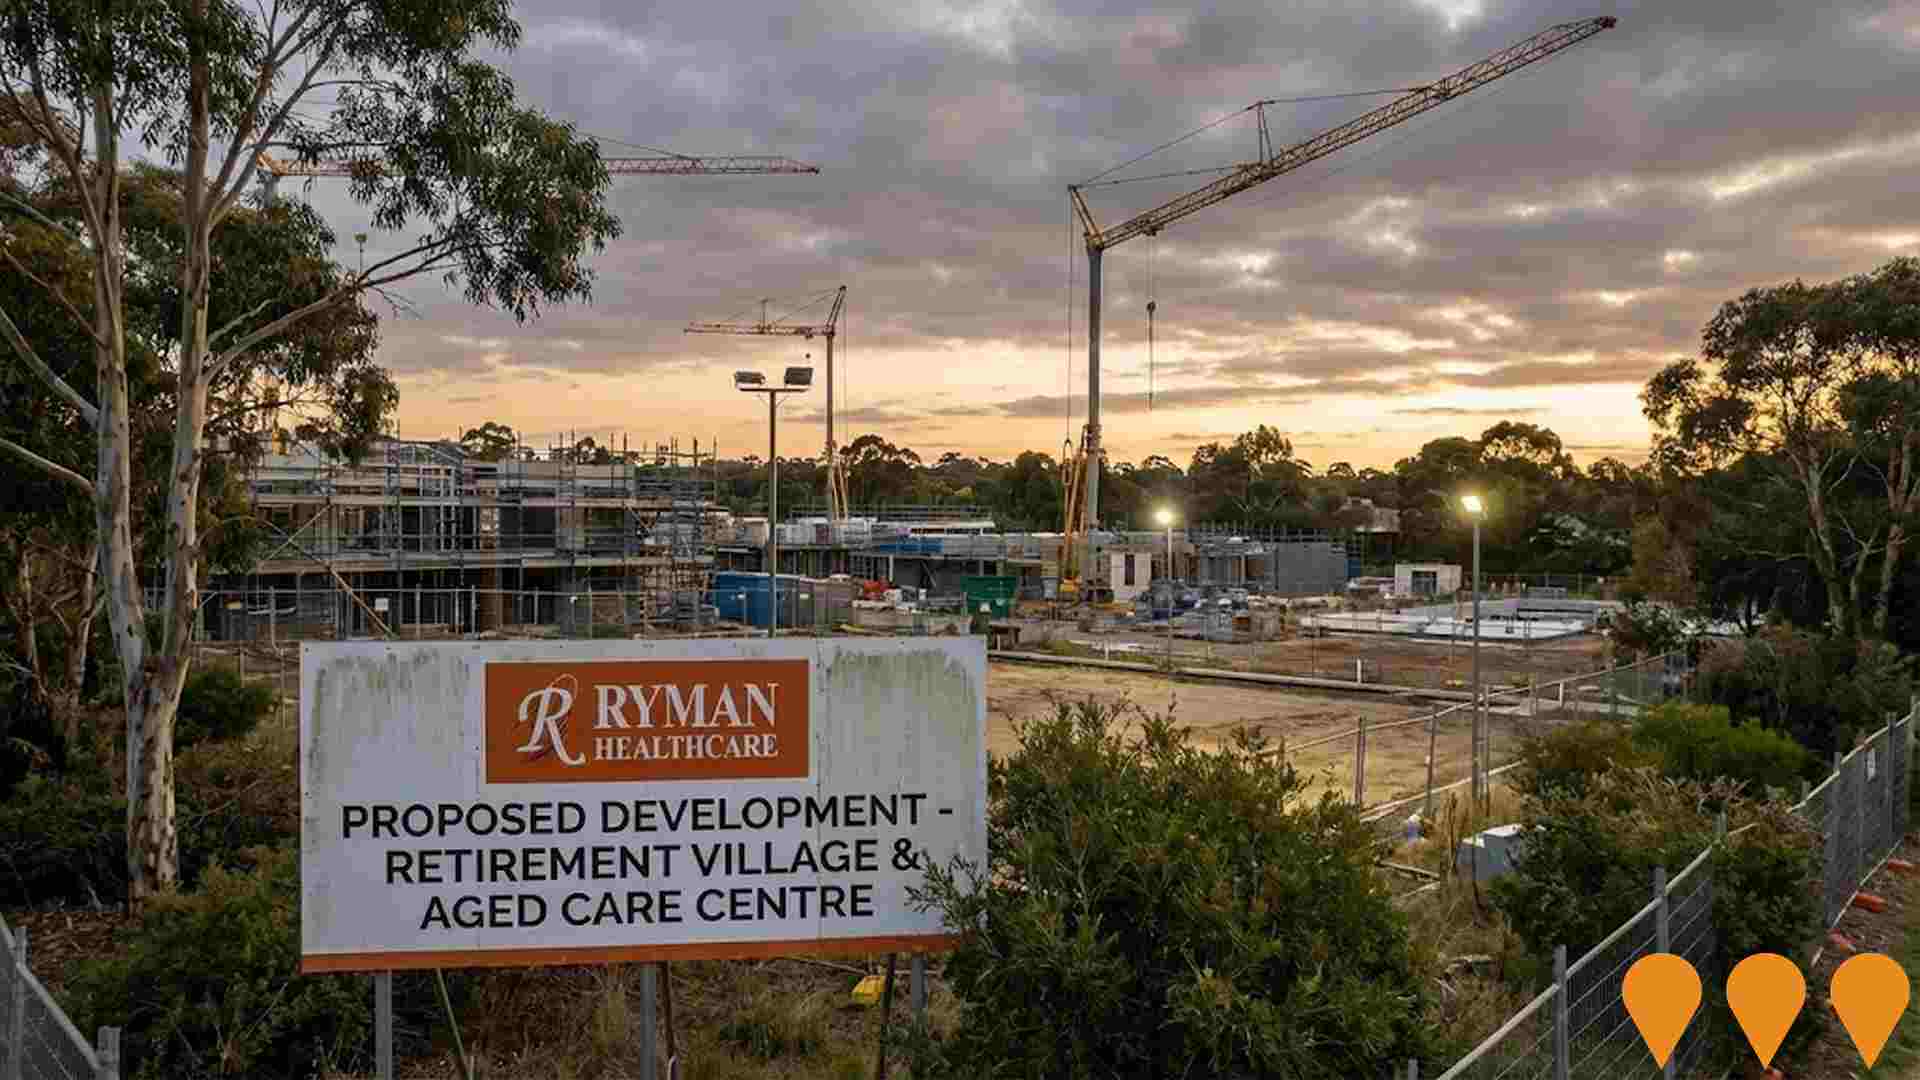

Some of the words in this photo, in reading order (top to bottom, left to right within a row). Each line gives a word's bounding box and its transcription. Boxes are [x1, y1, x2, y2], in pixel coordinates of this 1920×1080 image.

[516, 674, 587, 766] R
[592, 682, 779, 730] RYMAN
[594, 733, 779, 762] HEALTHCARE
[342, 801, 586, 839] PROPOSED
[601, 792, 927, 834] DEVELOPMENT
[385, 844, 681, 885] RETIREMENT
[690, 839, 879, 877] VILLAGE
[890, 837, 925, 872] &
[419, 892, 547, 931] AGED
[561, 890, 683, 926] CARE
[696, 885, 874, 922] CENTRE
